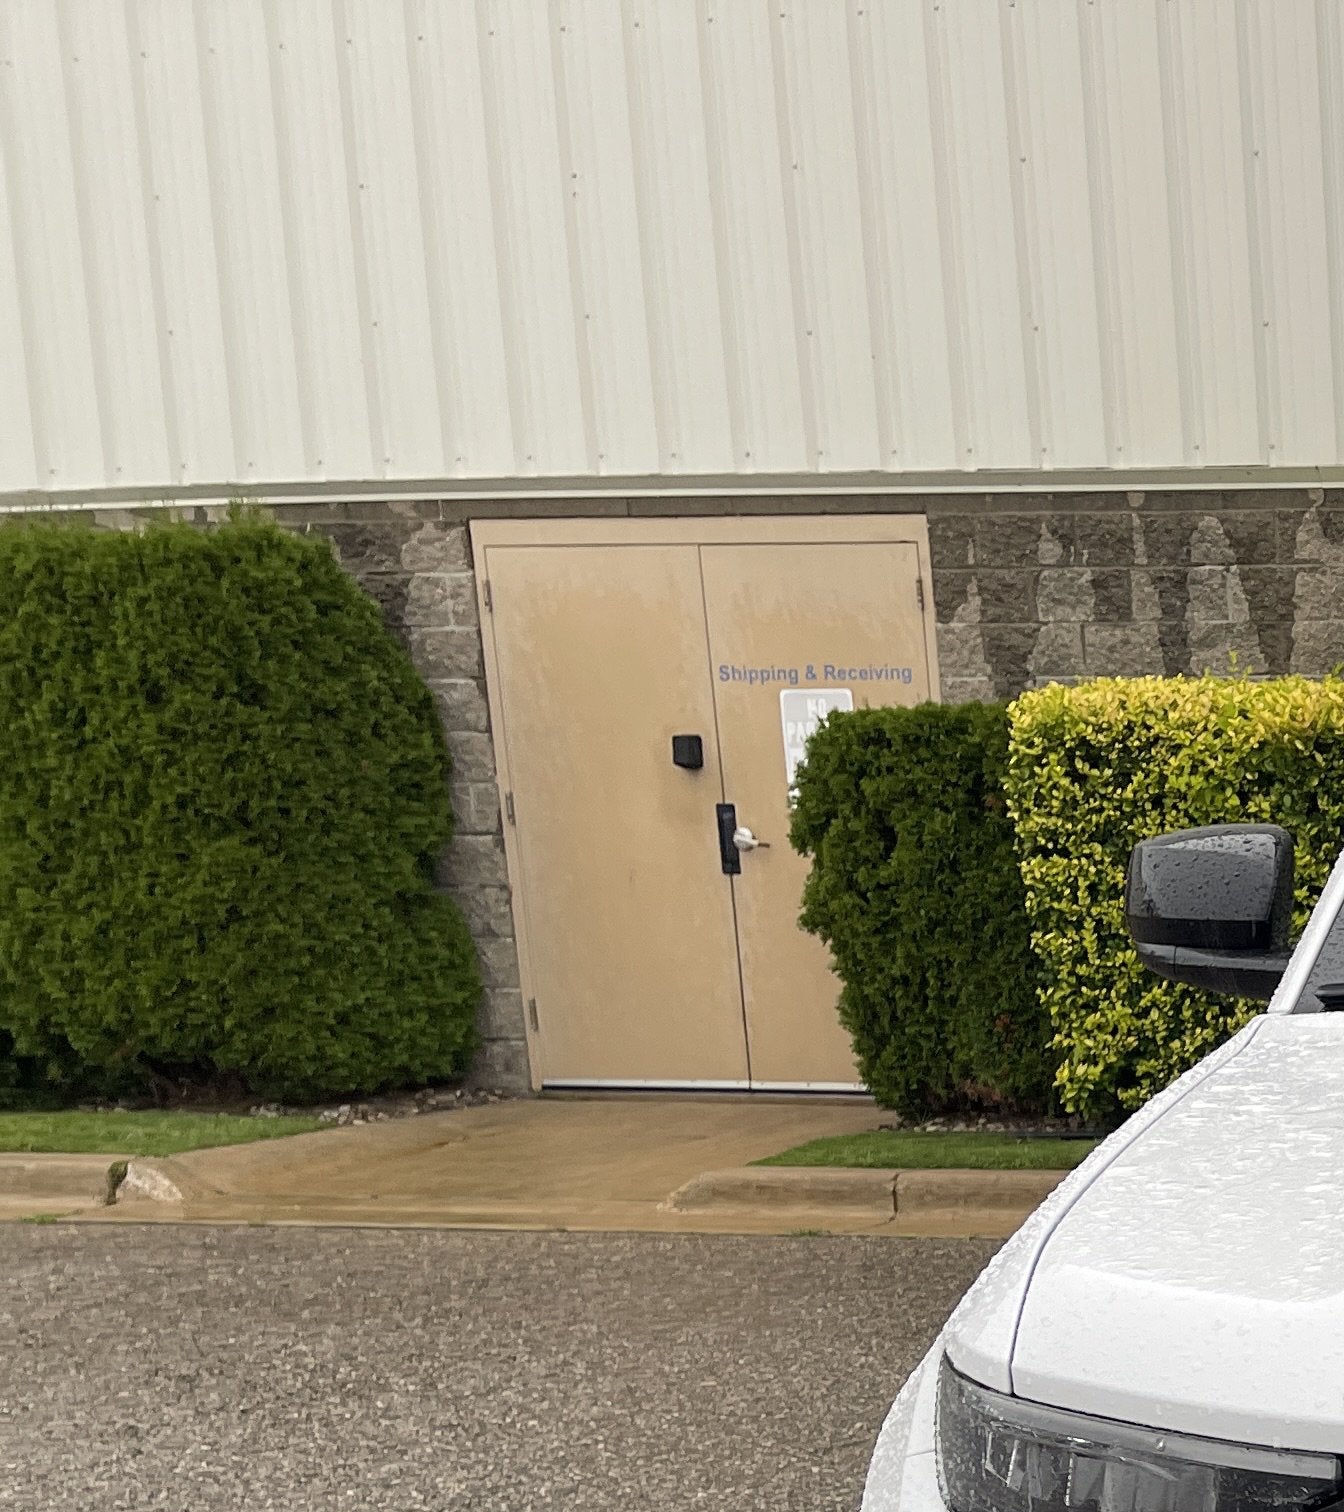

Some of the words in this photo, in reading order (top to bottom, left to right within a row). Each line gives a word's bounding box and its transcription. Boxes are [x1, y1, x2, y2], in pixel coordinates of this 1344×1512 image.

[719, 664, 799, 685] Shipping
[805, 665, 818, 681] &
[823, 664, 913, 683] Receiving
